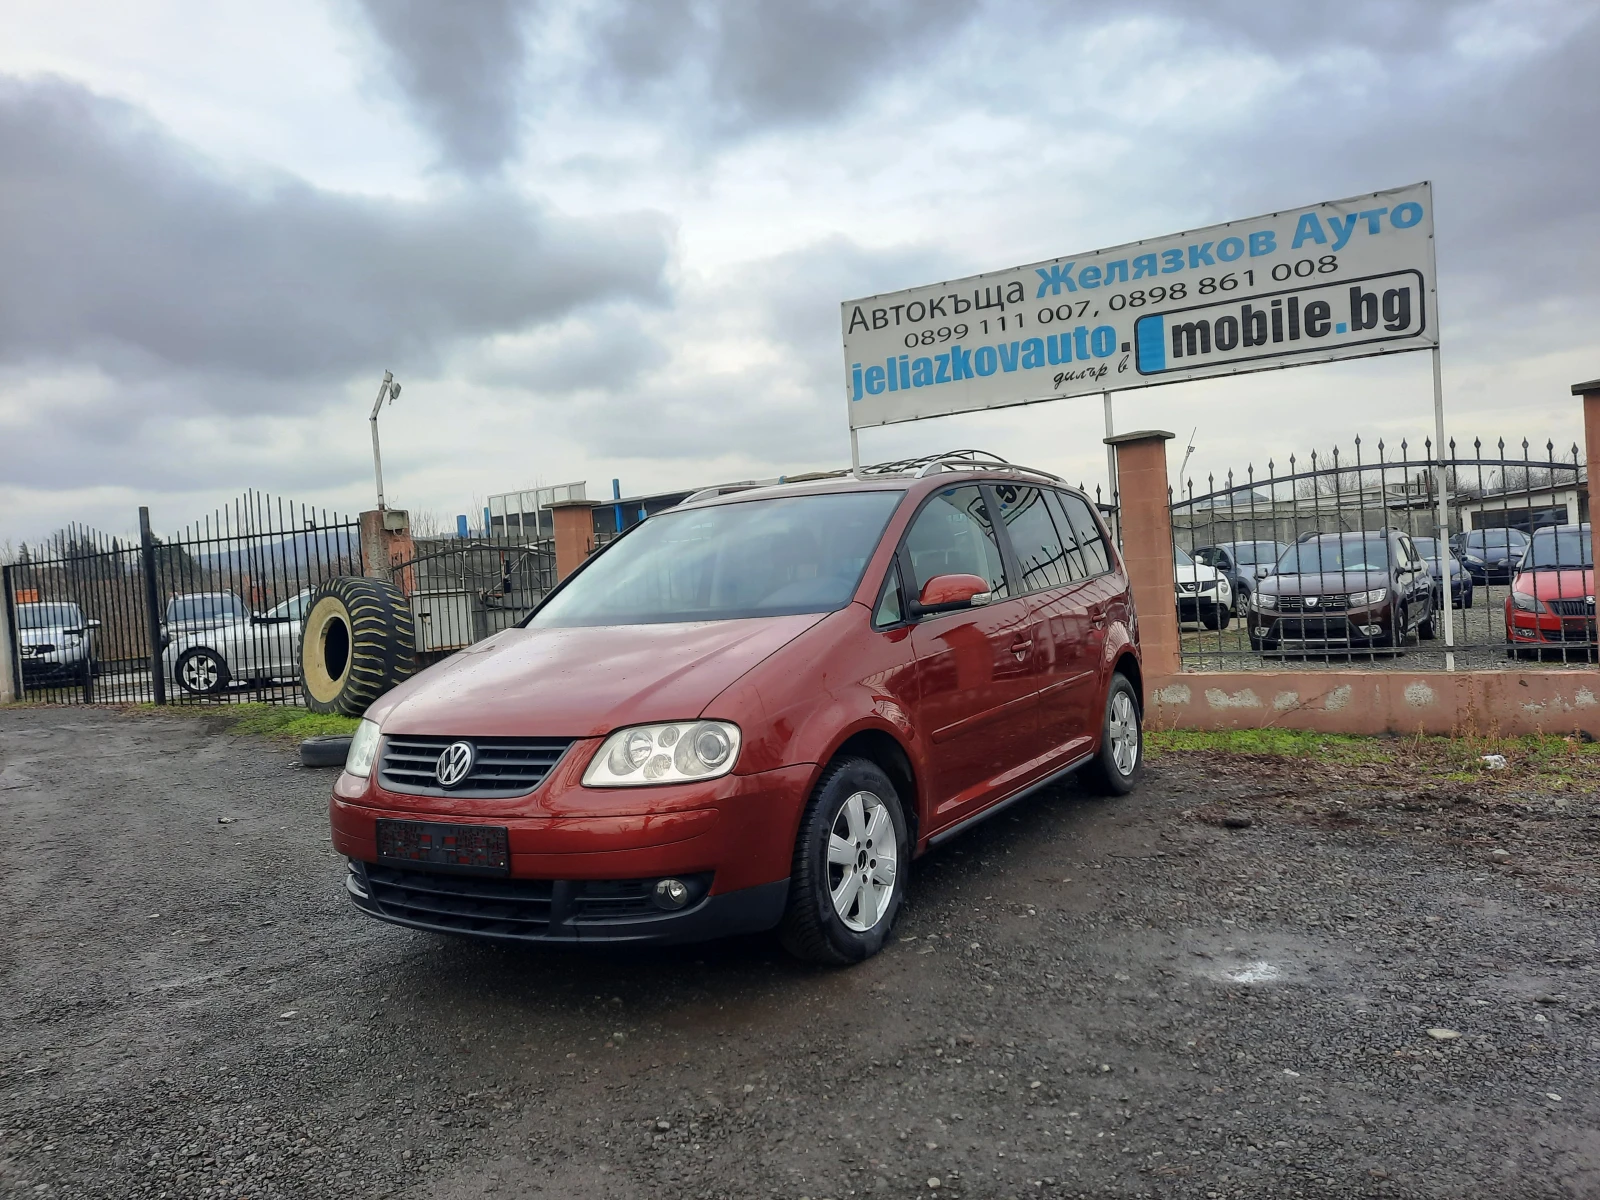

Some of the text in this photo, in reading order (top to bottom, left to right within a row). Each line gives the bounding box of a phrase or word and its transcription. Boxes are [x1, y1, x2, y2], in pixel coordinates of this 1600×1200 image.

[848, 201, 1424, 335] Автокъща Желязков Ауто
[904, 255, 1339, 348] 0899 111 007, 0898 861 008
[1172, 286, 1412, 358] mobile.bg
